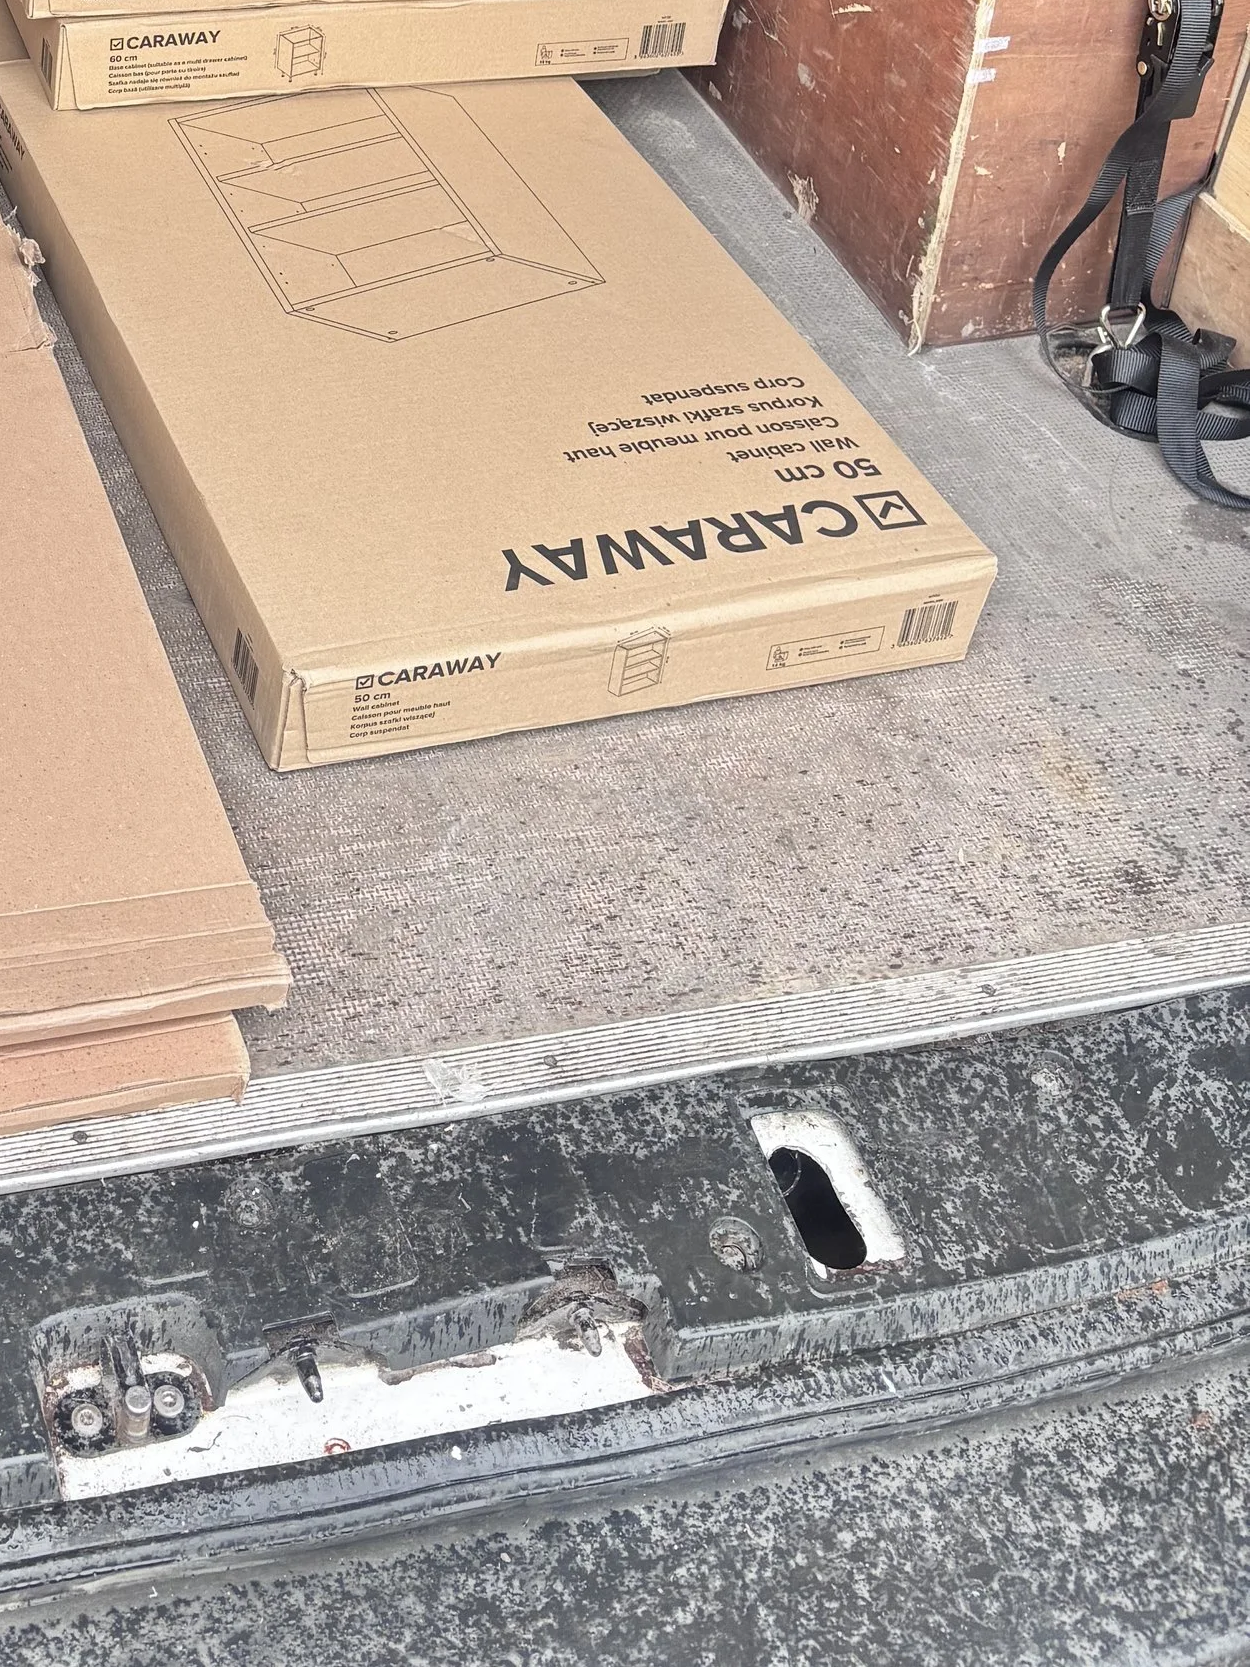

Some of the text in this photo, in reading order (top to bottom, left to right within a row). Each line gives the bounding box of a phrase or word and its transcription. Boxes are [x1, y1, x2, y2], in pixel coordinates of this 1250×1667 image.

[126, 30, 221, 50] CARAWAY
[109, 54, 138, 63] 60 cm
[642, 376, 805, 405] Corp suspendat
[587, 395, 823, 437] Korpus szafki wiszącej
[563, 416, 840, 463] Caisson pour meuble haut
[730, 436, 860, 463] Wall cabinet
[773, 458, 882, 483] 50 cm
[501, 499, 859, 592] CARAWAY
[378, 652, 502, 687] CARAWAY
[352, 700, 399, 712] Wall cabinet
[354, 692, 391, 703] 50 cm
[351, 700, 450, 721] Caisson pour meuble haut
[349, 724, 409, 739] Corp suspendat
[350, 720, 377, 730] Korpus
[379, 716, 401, 725] szafki
